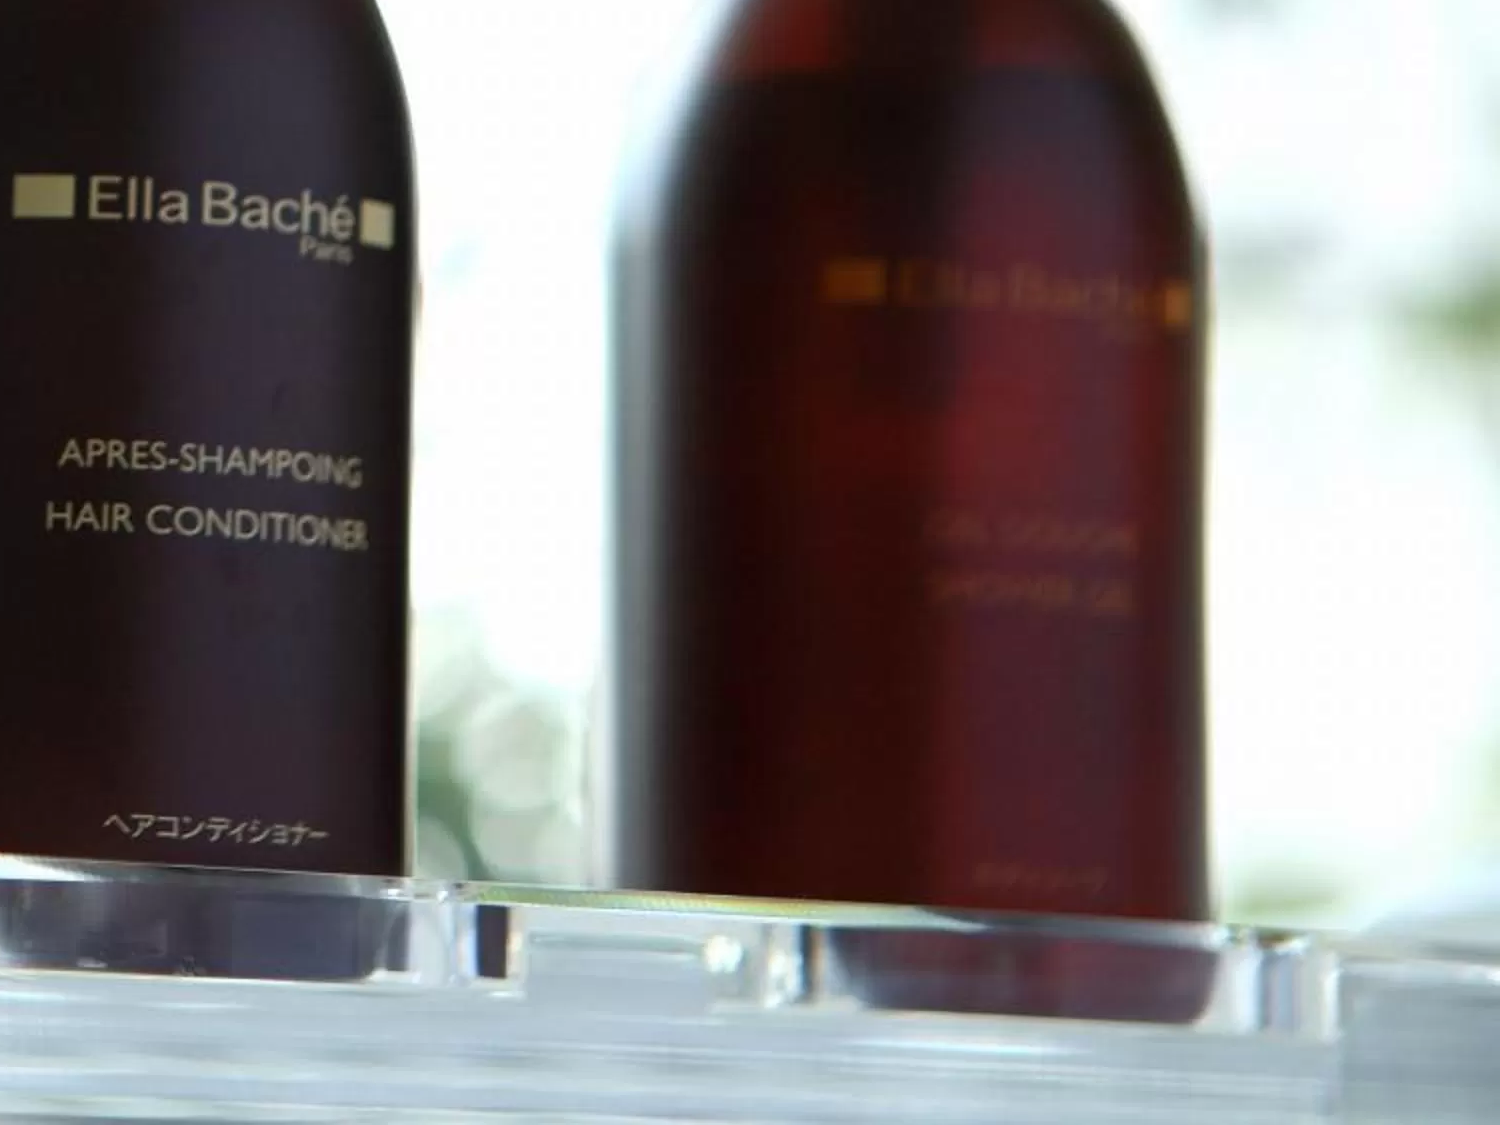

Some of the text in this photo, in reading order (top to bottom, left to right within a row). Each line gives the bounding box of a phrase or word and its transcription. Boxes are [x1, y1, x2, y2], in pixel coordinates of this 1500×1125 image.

[87, 175, 357, 240] Ella Baché
[301, 236, 355, 266] Paris
[57, 437, 364, 490] APRES-SHAMPOING
[45, 500, 370, 552] HAIR CONDITIONER
